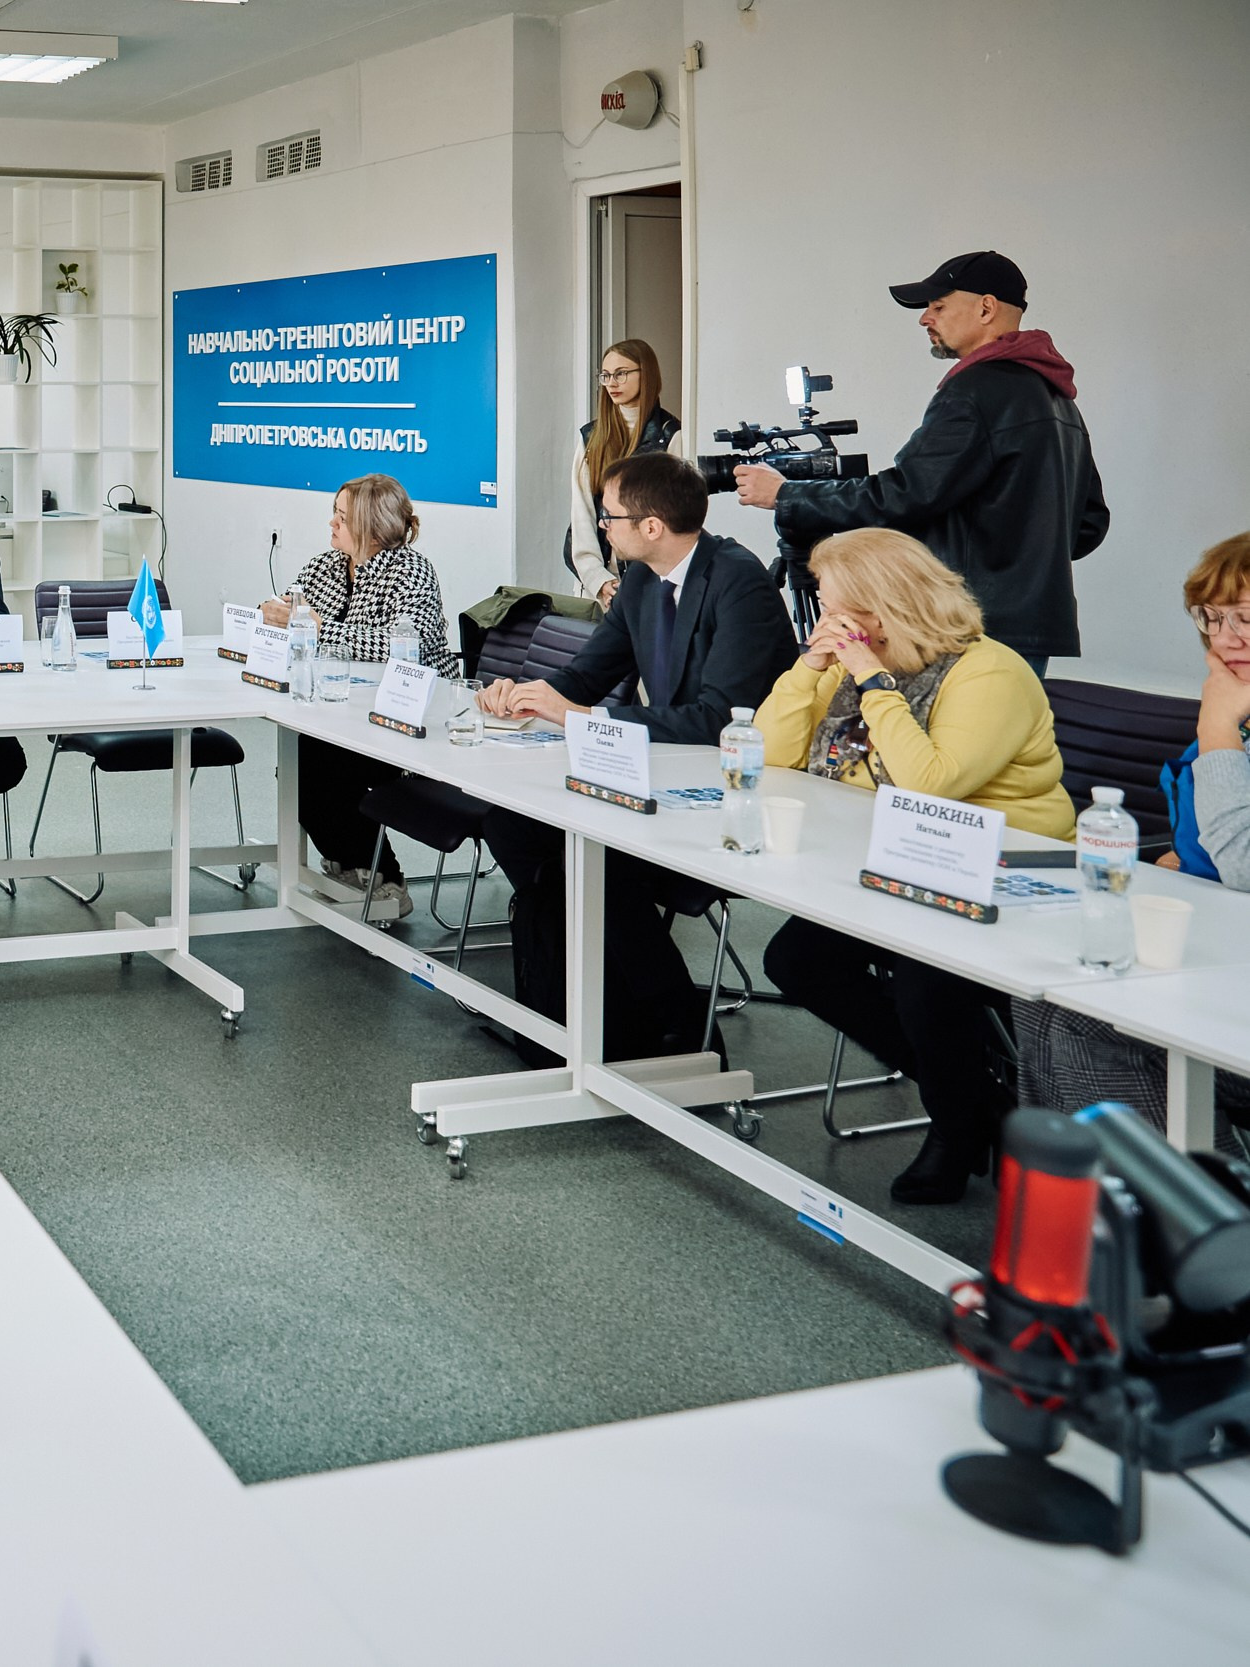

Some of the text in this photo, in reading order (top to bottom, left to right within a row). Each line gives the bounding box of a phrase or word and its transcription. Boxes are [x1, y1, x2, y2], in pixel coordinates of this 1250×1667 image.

[188, 313, 466, 354] НАВЧАЛЬНО-ТРЕНІНГОВИЙ ЦЕНТР
[229, 354, 400, 387] СОЦІАЛЬНОЇ РОБОТИ
[210, 424, 428, 453] ДНІПРОПЕТРОВСЬКА ОБЛАСТЬ
[255, 626, 289, 642] КРІСТЕНСЕН
[394, 664, 426, 680] РУНЕСОН
[587, 721, 623, 738] РУДИЧ
[890, 795, 985, 829] БЕЛЮКИНА
[915, 823, 952, 839] Наталія
